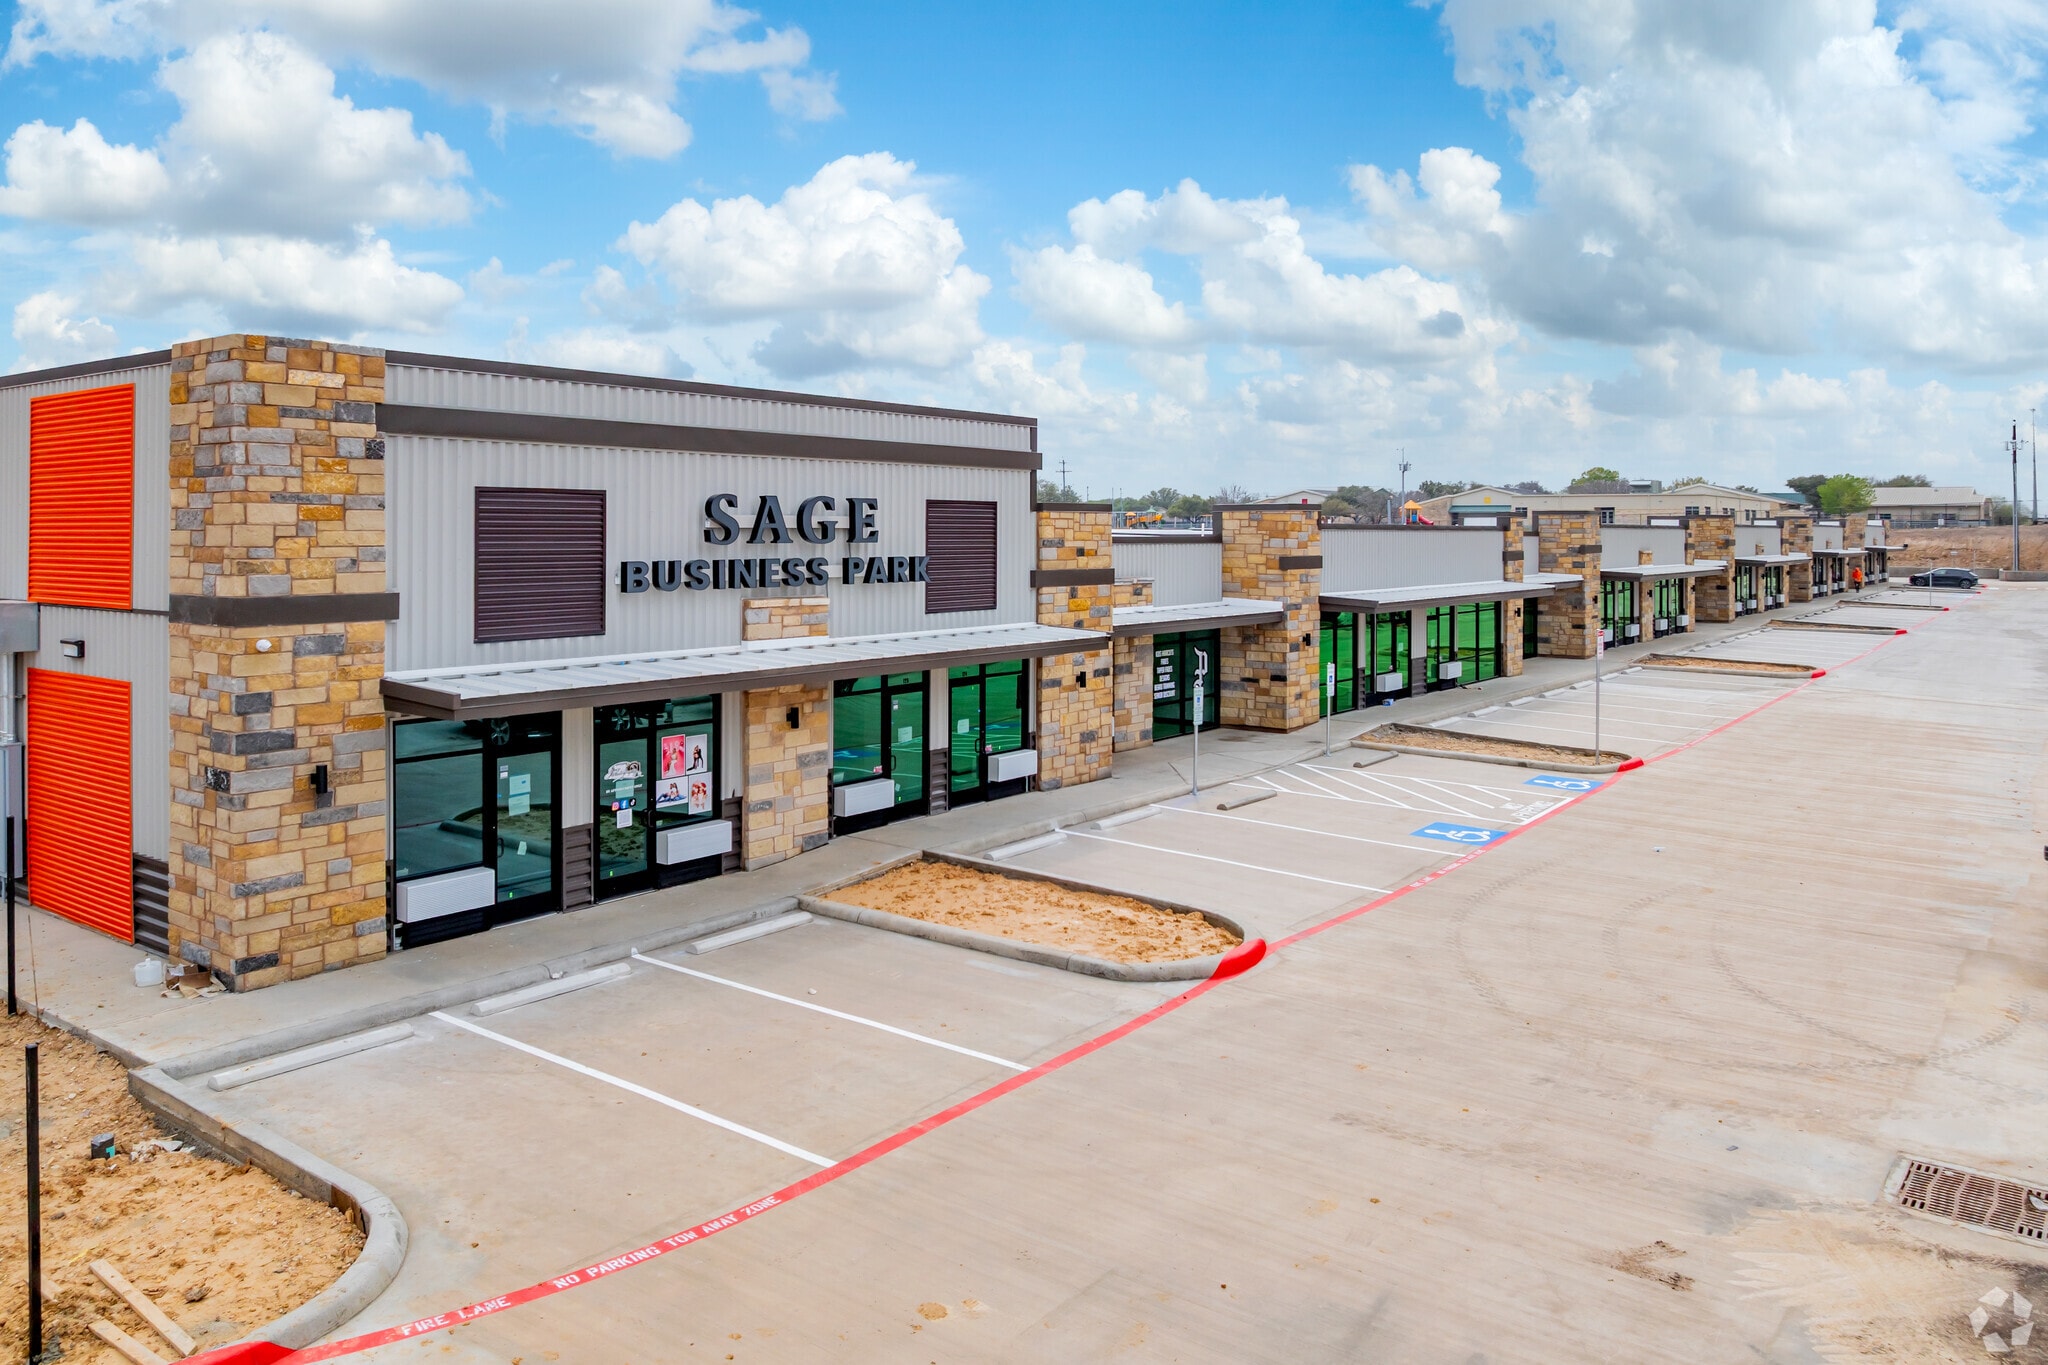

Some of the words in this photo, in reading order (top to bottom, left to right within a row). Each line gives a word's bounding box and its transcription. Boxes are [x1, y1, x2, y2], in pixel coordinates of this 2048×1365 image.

[704, 493, 879, 545] SAGE
[621, 557, 829, 593] BUSINESS
[842, 556, 932, 584] PARK
[401, 1314, 449, 1337] FIRE
[457, 1296, 511, 1319] LANE
[552, 1273, 580, 1290] NO
[586, 1246, 661, 1279] PARKING
[664, 1230, 699, 1248] TOW
[702, 1214, 738, 1235] AWAY
[740, 1195, 782, 1217] ZONE
